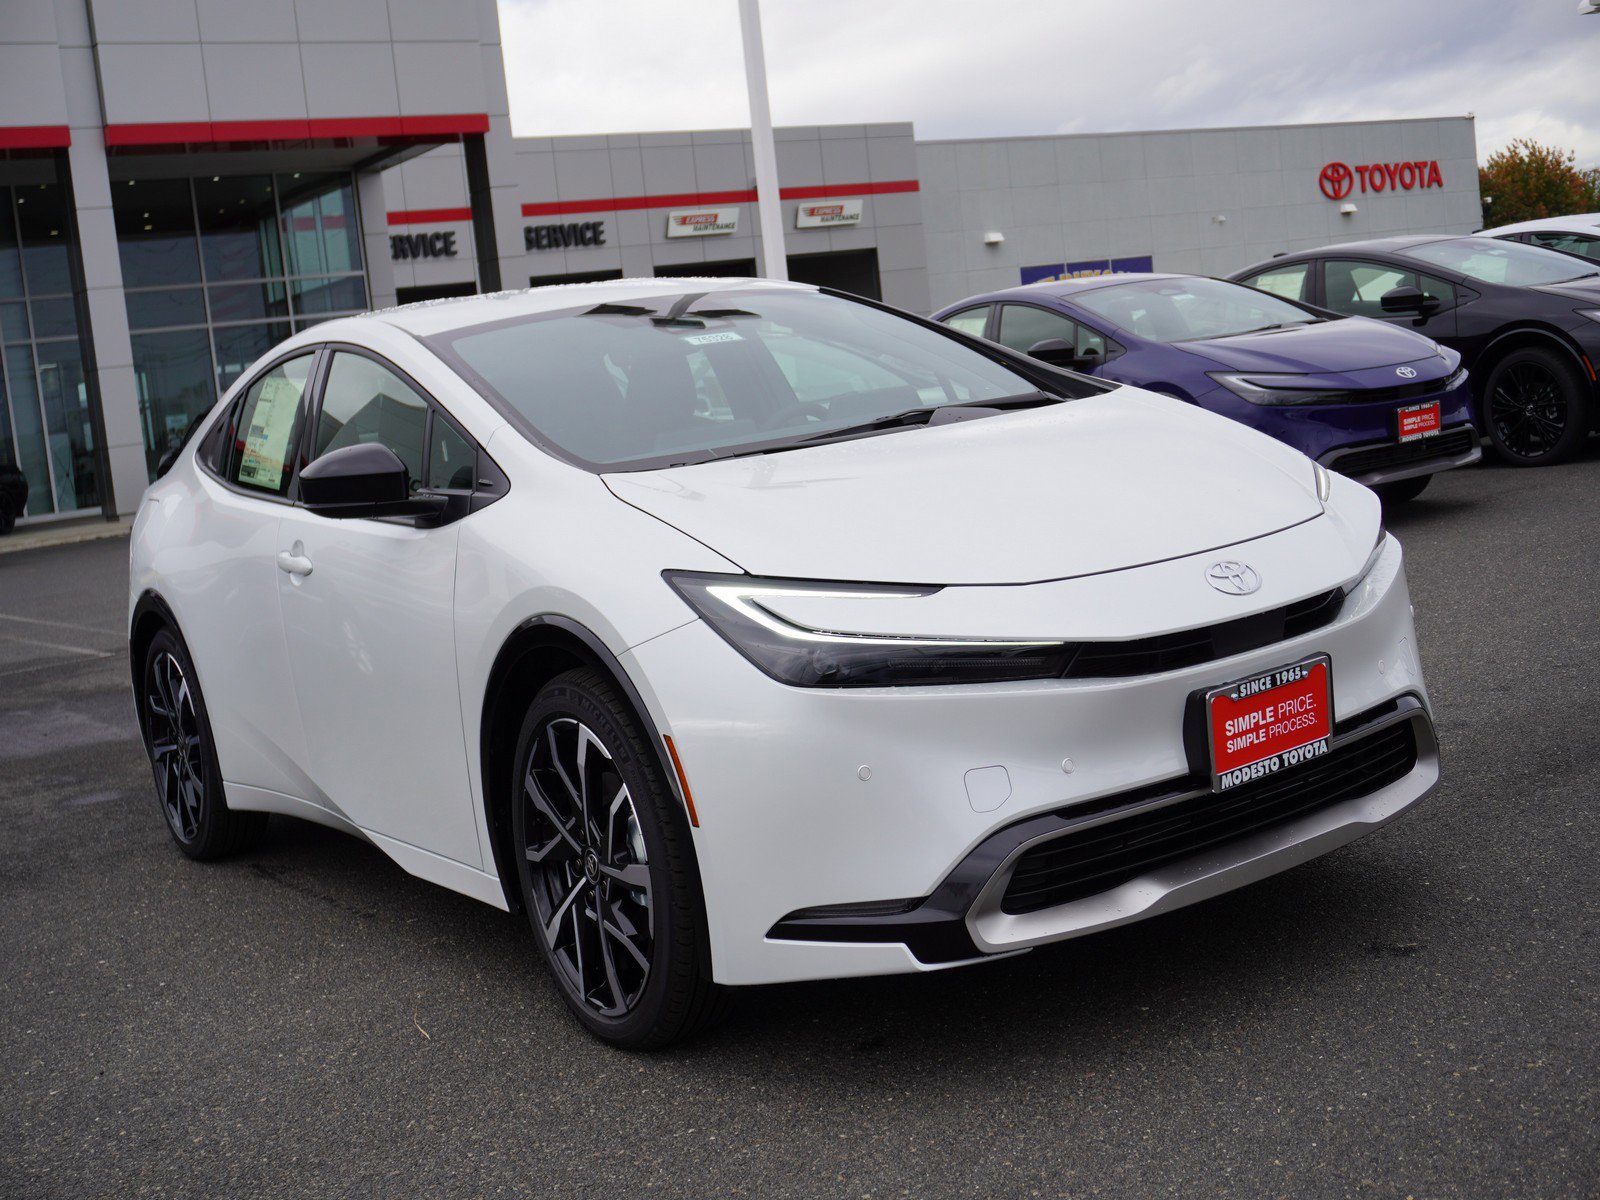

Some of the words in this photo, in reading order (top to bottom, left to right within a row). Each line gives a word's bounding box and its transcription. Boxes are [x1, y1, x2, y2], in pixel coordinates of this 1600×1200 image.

[1355, 160, 1443, 193] TOYOTA
[686, 213, 716, 225] EXPRESS
[693, 222, 735, 232] MAINTENANCE
[389, 231, 457, 260] RVICE
[524, 221, 606, 250] SERVICE
[1240, 676, 1272, 697] SINCE
[1275, 667, 1301, 686] 1965
[1225, 706, 1275, 737] SIMPLE
[1278, 693, 1317, 719] PRICE.
[1226, 728, 1266, 753] SIMPLE
[1269, 712, 1318, 738] PROCESS.
[1221, 757, 1279, 790] MODESTO
[1282, 740, 1328, 767] TOYOTA
